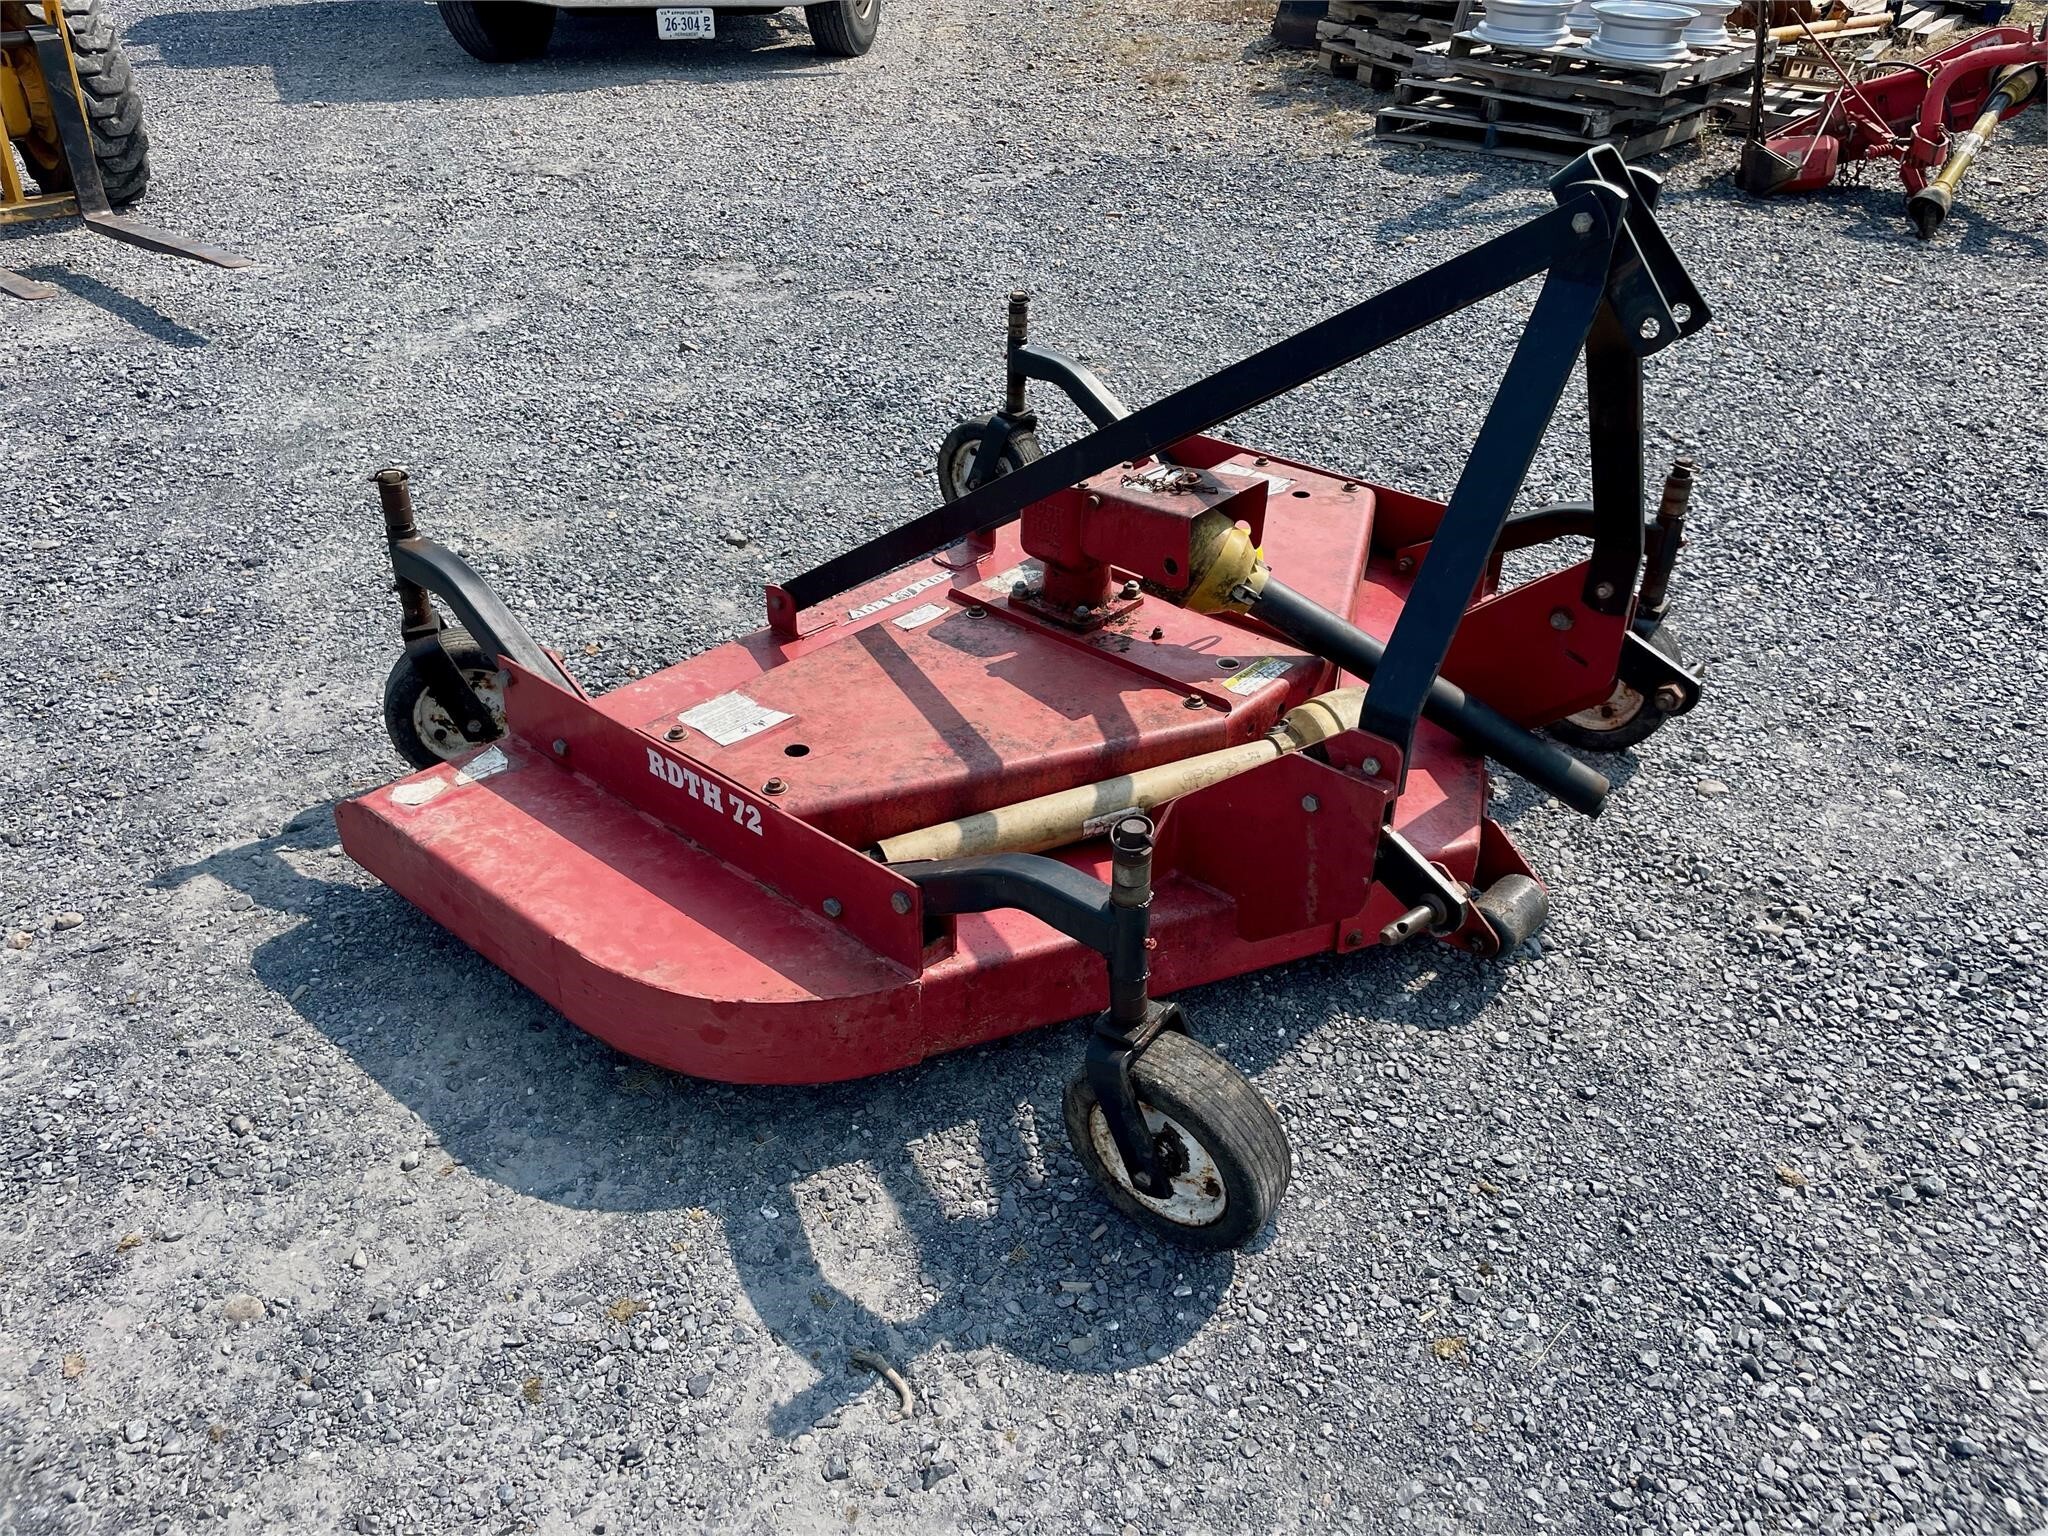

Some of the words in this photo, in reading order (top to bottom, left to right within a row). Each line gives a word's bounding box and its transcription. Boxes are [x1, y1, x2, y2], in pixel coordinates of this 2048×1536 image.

[664, 17, 701, 32] 26-304
[646, 747, 724, 814] RDTH
[728, 793, 763, 837] 72
